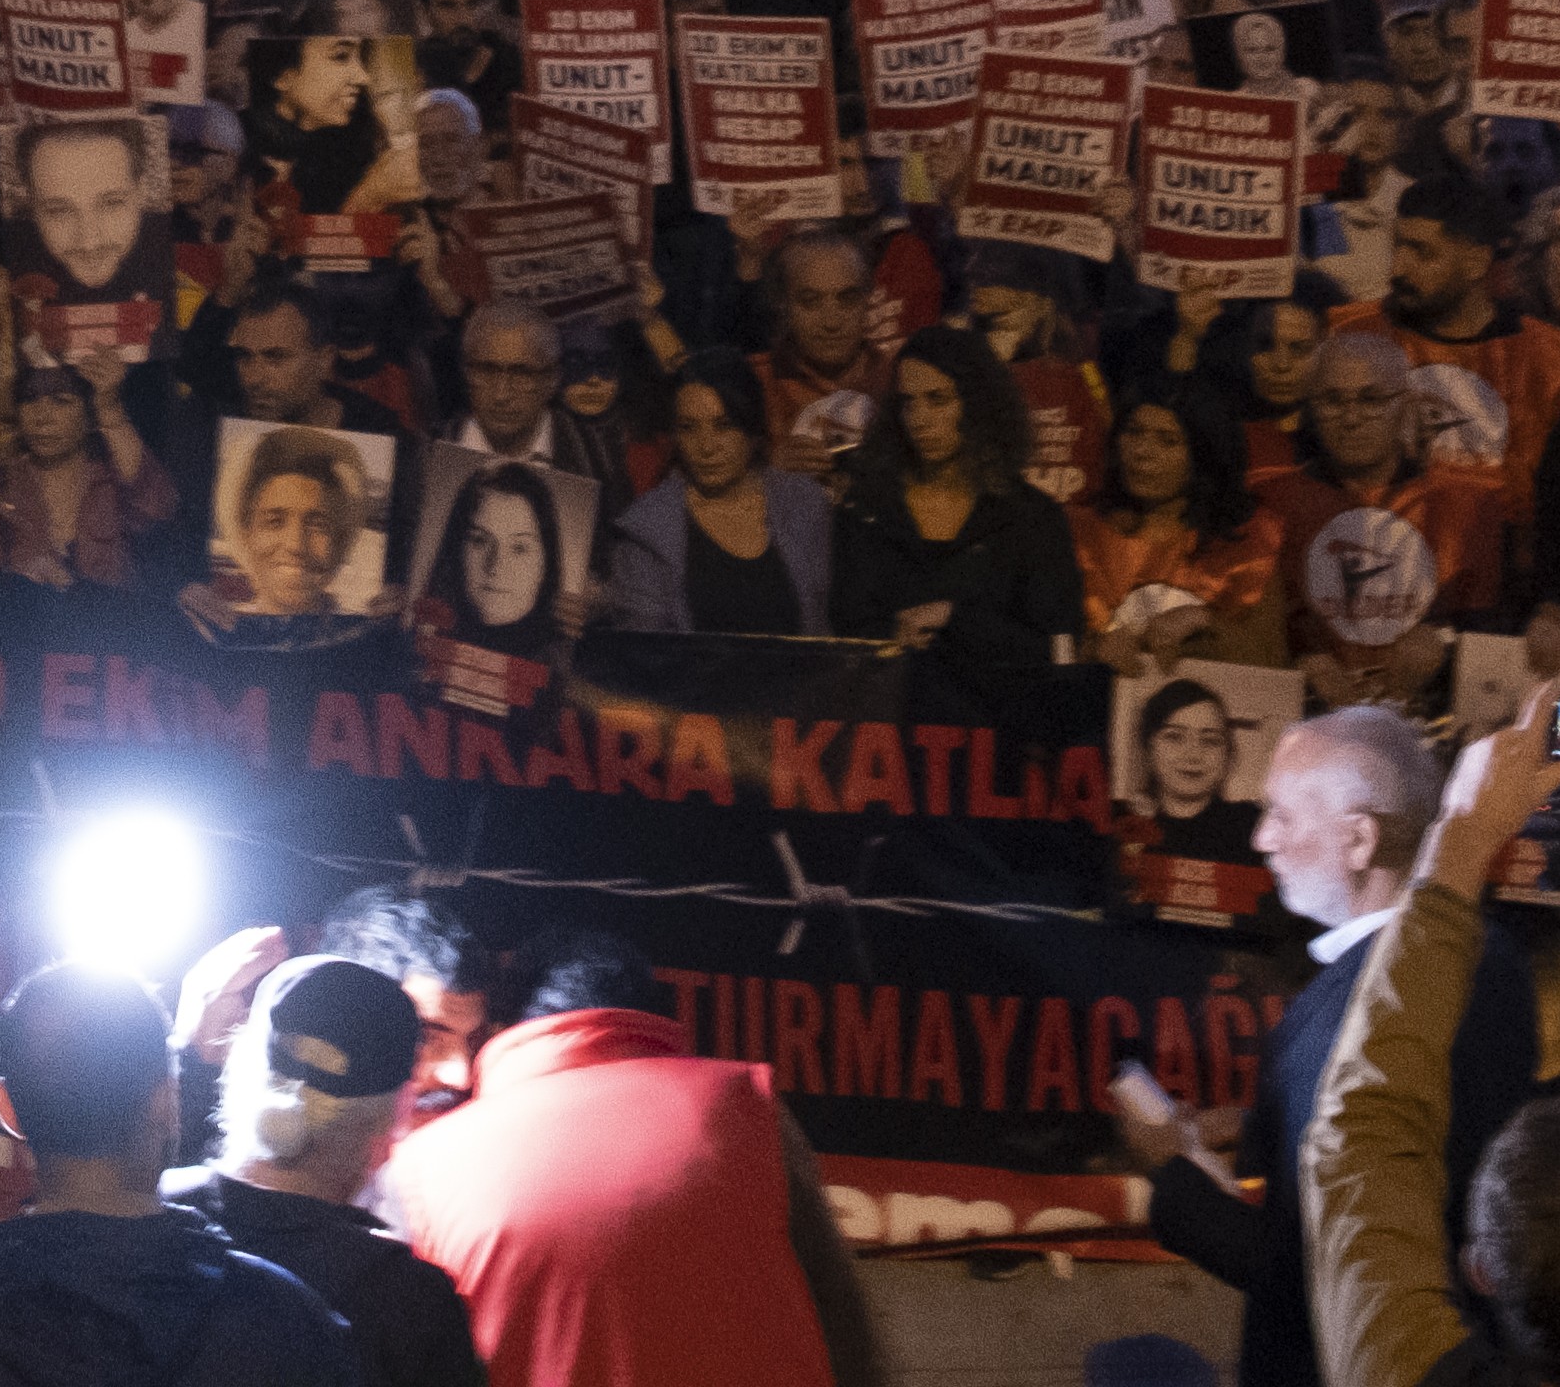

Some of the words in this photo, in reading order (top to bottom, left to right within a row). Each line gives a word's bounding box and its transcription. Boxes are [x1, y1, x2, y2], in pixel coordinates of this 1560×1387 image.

[16, 24, 109, 53] UNUT-
[882, 38, 980, 72] UNUT-
[17, 55, 111, 88] MADIK
[546, 64, 646, 89] UNUT-
[995, 123, 1103, 155] UNUT-
[986, 157, 1098, 192] MADIK
[1163, 162, 1273, 196] UNUT-
[1157, 199, 1271, 234] MADIK
[308, 689, 736, 807] ANKARA
[770, 714, 1111, 828] KATLİA
